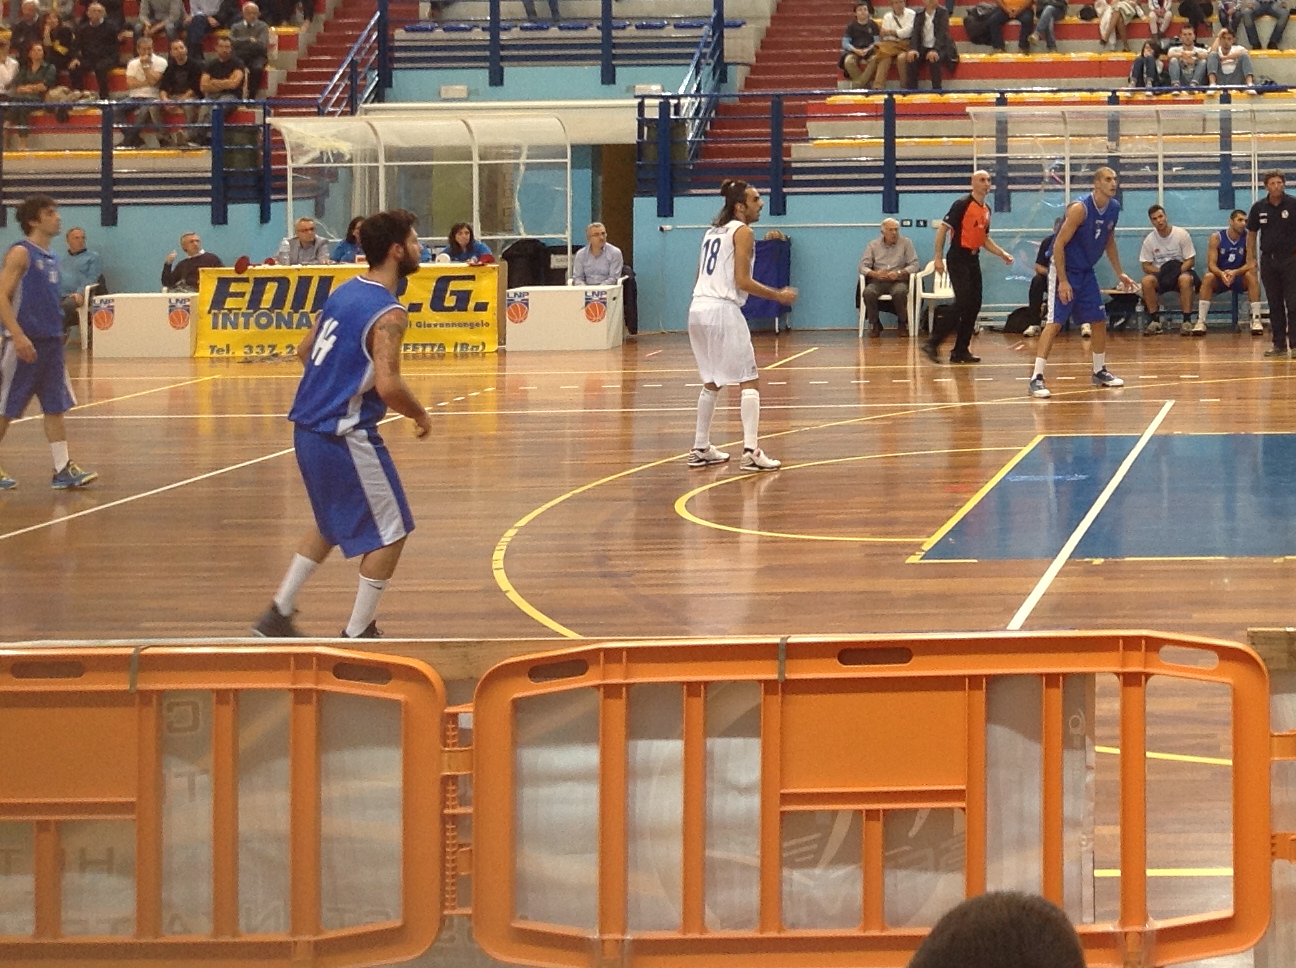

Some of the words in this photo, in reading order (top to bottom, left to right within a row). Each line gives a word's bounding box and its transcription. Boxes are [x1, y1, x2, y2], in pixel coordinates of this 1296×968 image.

[702, 237, 721, 276] 18
[507, 291, 530, 299] LNP
[585, 291, 608, 299] LNP
[211, 311, 313, 330] INTONA
[415, 320, 491, 329] Giovannangelo
[208, 343, 236, 355] Tel.
[243, 343, 297, 355] 337.2
[403, 342, 447, 352] FETTA
